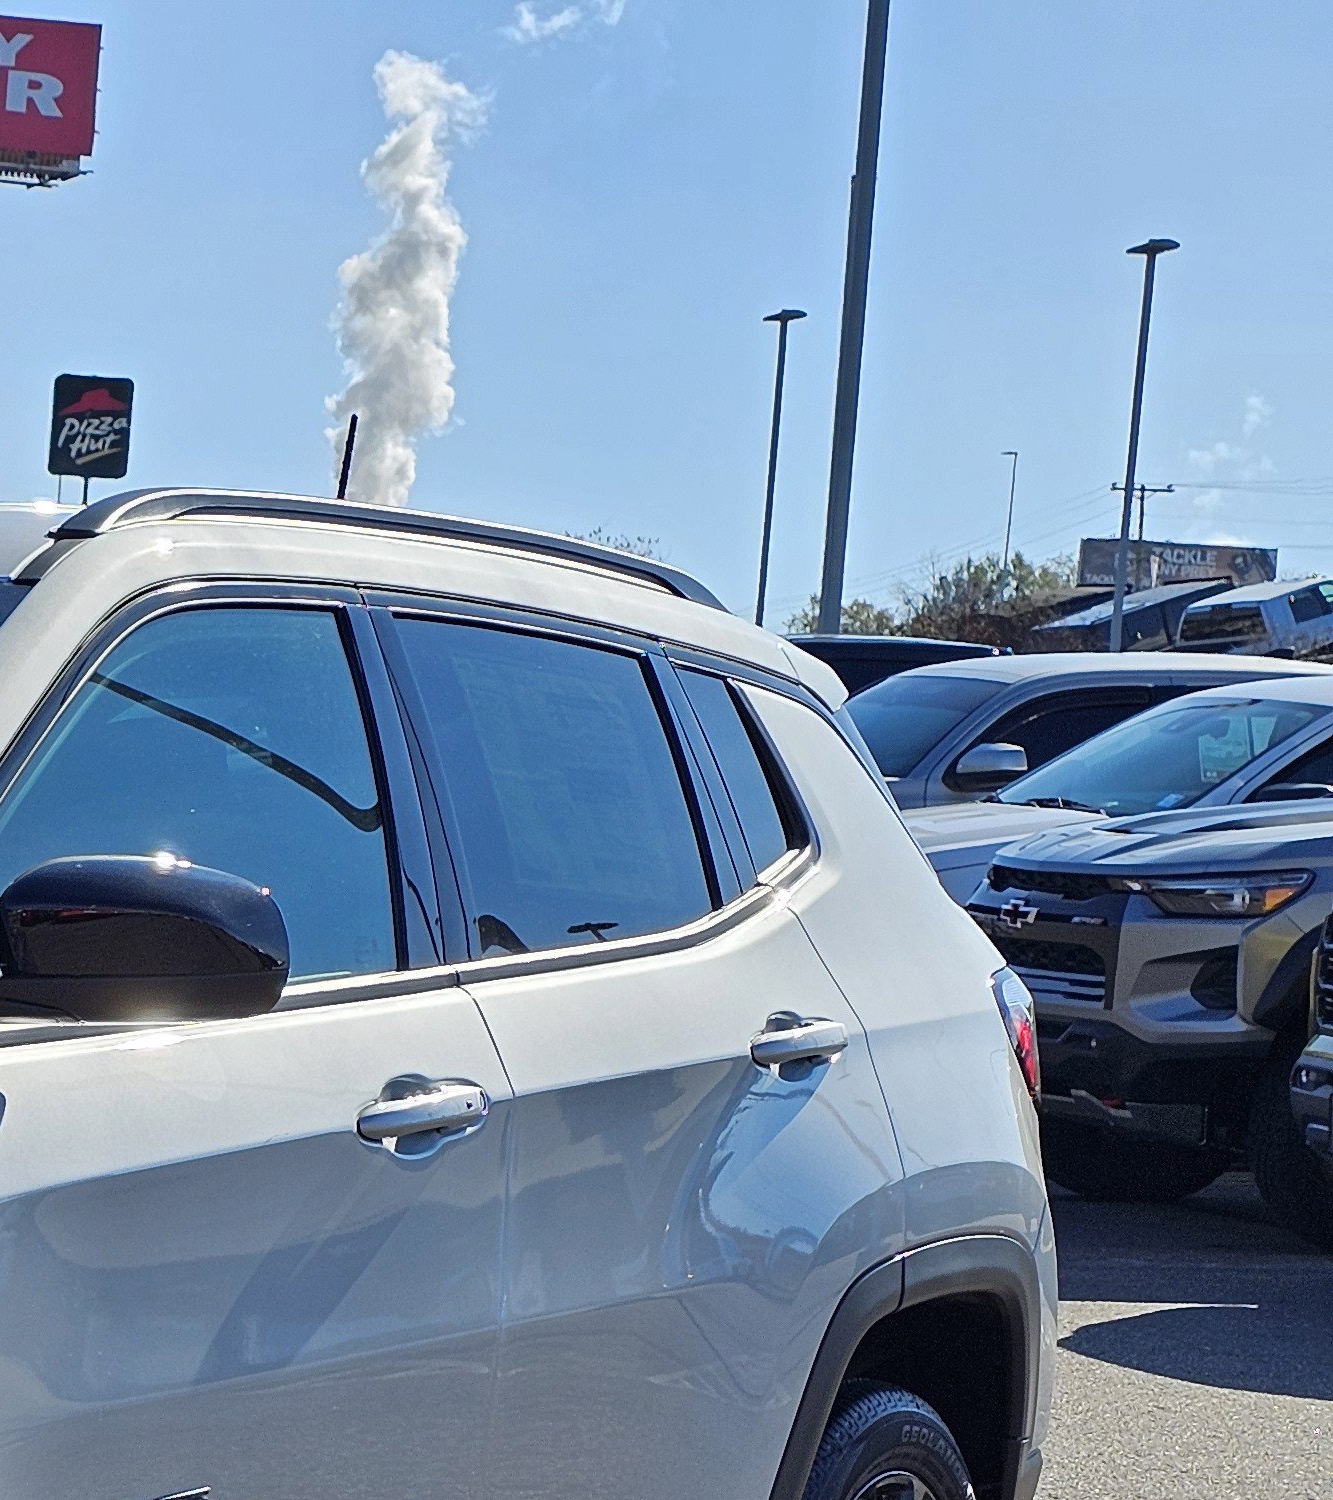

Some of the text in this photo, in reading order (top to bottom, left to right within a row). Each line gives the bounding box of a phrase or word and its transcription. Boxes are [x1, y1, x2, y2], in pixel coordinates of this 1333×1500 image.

[58, 416, 129, 448] Pizza
[69, 433, 121, 459] Hut
[1151, 547, 1217, 566] TACKLE
